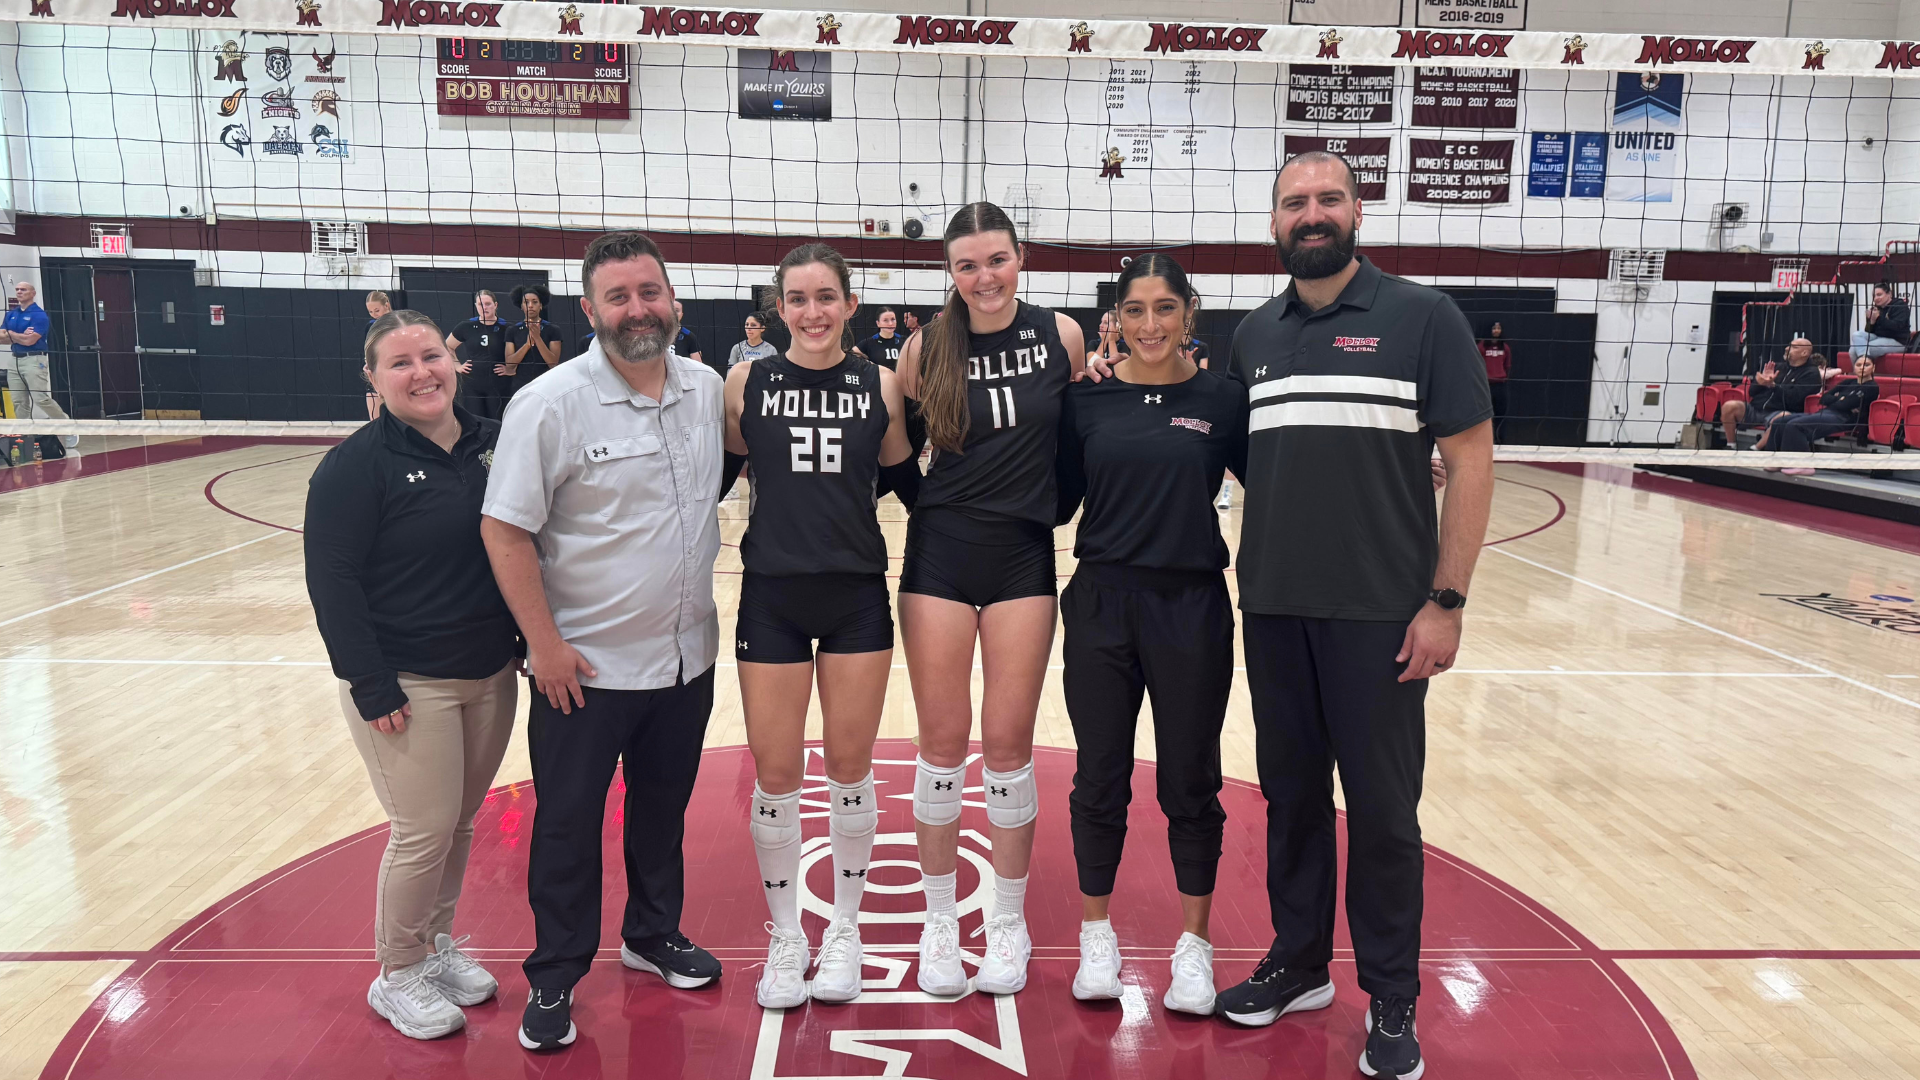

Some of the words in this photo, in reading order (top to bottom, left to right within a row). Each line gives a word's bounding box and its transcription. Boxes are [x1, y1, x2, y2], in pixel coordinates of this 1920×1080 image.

[111, 0, 238, 21] MOLLOY
[1456, 0, 1518, 8] BASKETBALL
[377, 2, 504, 30] MOLLOY
[637, 6, 764, 39] MOLLOY
[893, 15, 1017, 48] MOLLOY
[1144, 23, 1268, 56] MOLLOY
[1391, 30, 1514, 62] MOLLOY
[481, 42, 490, 58] 2
[573, 44, 582, 60] 2
[1635, 35, 1757, 67] MOLLOY
[441, 64, 470, 74] SCORE
[516, 66, 546, 76] MATCH
[594, 68, 622, 77] SCORE
[1331, 65, 1353, 75] ECC
[1420, 67, 1447, 77] NCAA
[1452, 68, 1513, 78] TOURNAMENT
[744, 82, 773, 92] MAKE
[774, 83, 784, 92] IT
[785, 77, 825, 97] YOURS
[1290, 74, 1343, 89] CONFERENCE
[1347, 76, 1393, 90] CHAMPIONS
[1457, 83, 1512, 92] BASKETBALL
[445, 81, 492, 100] BOB
[499, 82, 621, 103] HOULIHAN
[1290, 89, 1328, 104] WOMEN'S
[1331, 91, 1391, 106] BASKETBALL
[485, 100, 581, 115] GYMNASIUM
[1414, 96, 1435, 105] 2008
[1442, 97, 1462, 106] 2010
[1468, 98, 1488, 106] 2017
[1495, 98, 1516, 107] 2020
[1305, 106, 1374, 120] 2016-2017
[319, 138, 349, 154] CSI
[1326, 139, 1348, 153] ECC
[1614, 131, 1675, 150] UNITED
[1342, 155, 1387, 169] HAMPIONS
[1416, 157, 1450, 170] WOMEN'S
[1453, 159, 1505, 170] BASKETBALL
[1626, 152, 1639, 162] AS
[1642, 153, 1660, 162] ONE
[1410, 173, 1464, 185] CONFERENCE
[1465, 174, 1509, 185] CHAMPIONS
[1427, 189, 1491, 199] 2009-2010
[102, 236, 125, 254] EXIT
[1777, 271, 1799, 289] EXIT
[480, 334, 489, 347] 3
[1019, 329, 1036, 340] BH
[1333, 336, 1380, 347] MOLLOY
[886, 349, 899, 360] 10
[968, 344, 1048, 381] OLLOY
[845, 374, 860, 386] BH
[761, 389, 871, 420] MOLLOY
[987, 386, 1016, 429] 11
[1170, 417, 1212, 431] MOLLOY
[788, 426, 842, 474] 26
